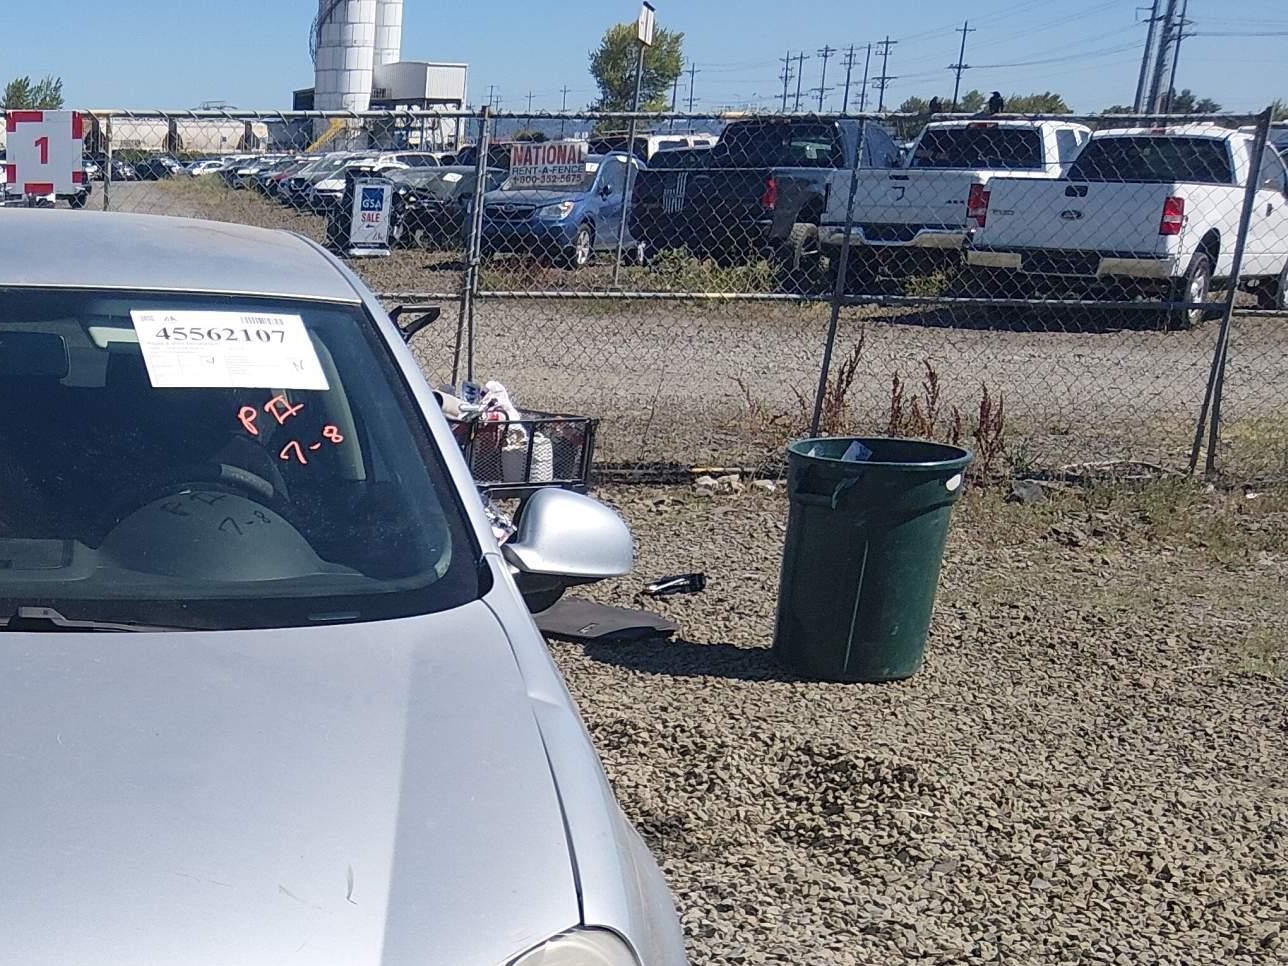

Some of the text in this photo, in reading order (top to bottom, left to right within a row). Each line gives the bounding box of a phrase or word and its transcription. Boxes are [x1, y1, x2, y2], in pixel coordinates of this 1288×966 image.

[34, 136, 48, 164] 1
[513, 144, 585, 165] NATIONAL
[512, 165, 584, 175] RENT-A-FENCE
[362, 199, 382, 208] GSA
[360, 212, 381, 223] SALE
[155, 327, 285, 343] 45562107
[280, 425, 344, 464] 7-8
